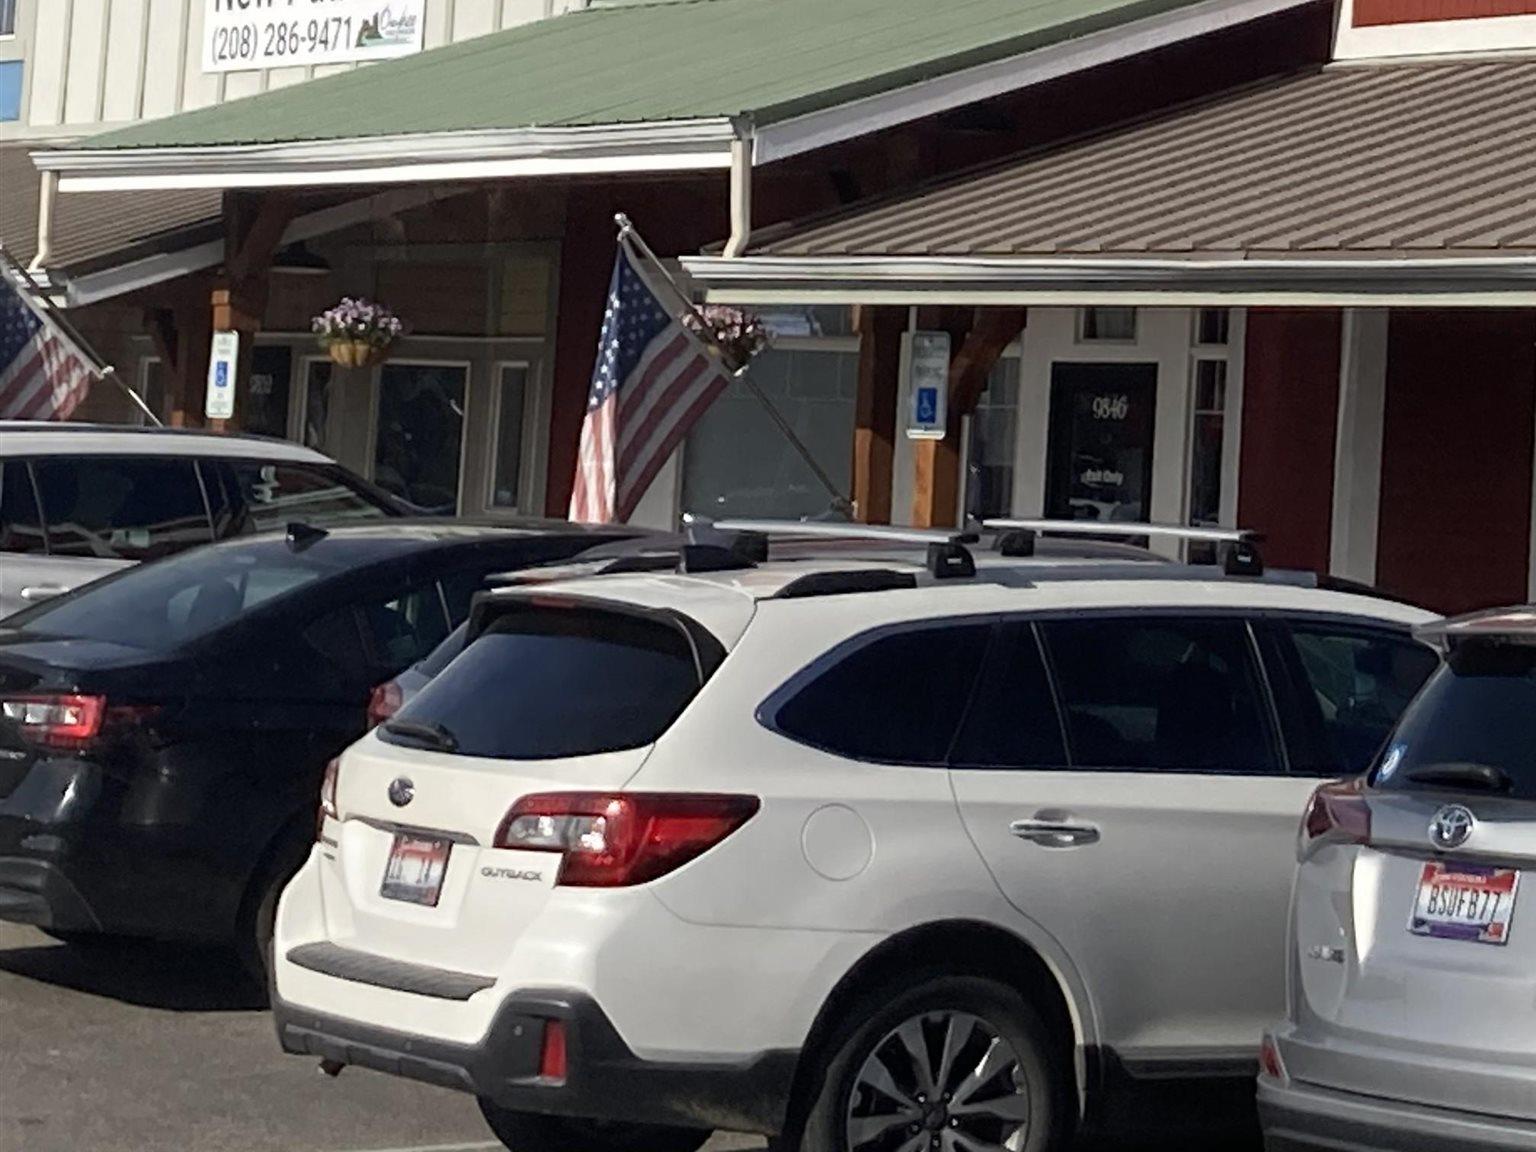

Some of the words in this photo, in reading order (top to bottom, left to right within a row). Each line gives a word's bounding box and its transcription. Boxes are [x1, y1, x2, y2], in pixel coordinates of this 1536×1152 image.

[212, 22, 258, 65] (208)
[264, 16, 352, 57] 286-9471
[480, 866, 543, 882] OUTBACK
